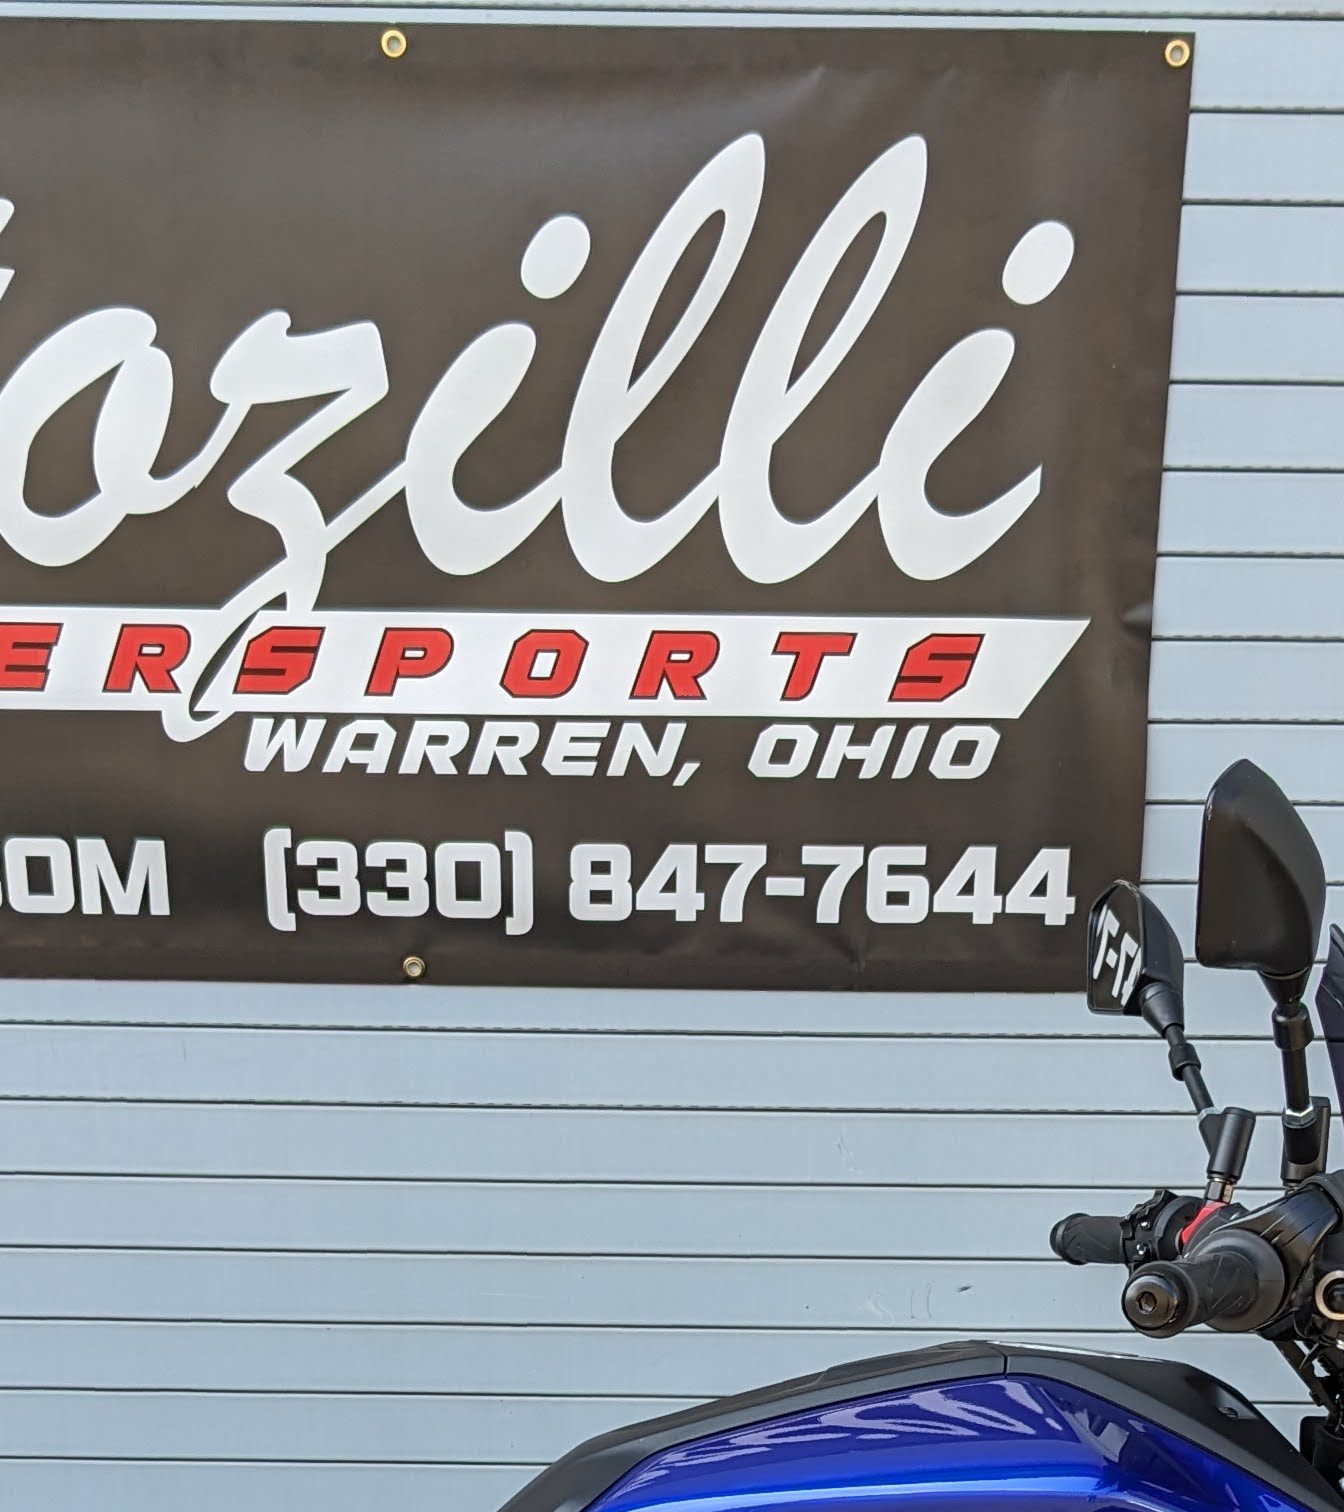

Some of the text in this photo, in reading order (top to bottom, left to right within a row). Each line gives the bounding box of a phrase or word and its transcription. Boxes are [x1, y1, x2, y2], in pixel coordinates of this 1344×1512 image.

[244, 718, 1000, 787] WARREN, OHIO
[264, 828, 533, 935] (330)
[569, 844, 1075, 926] 847-7644
